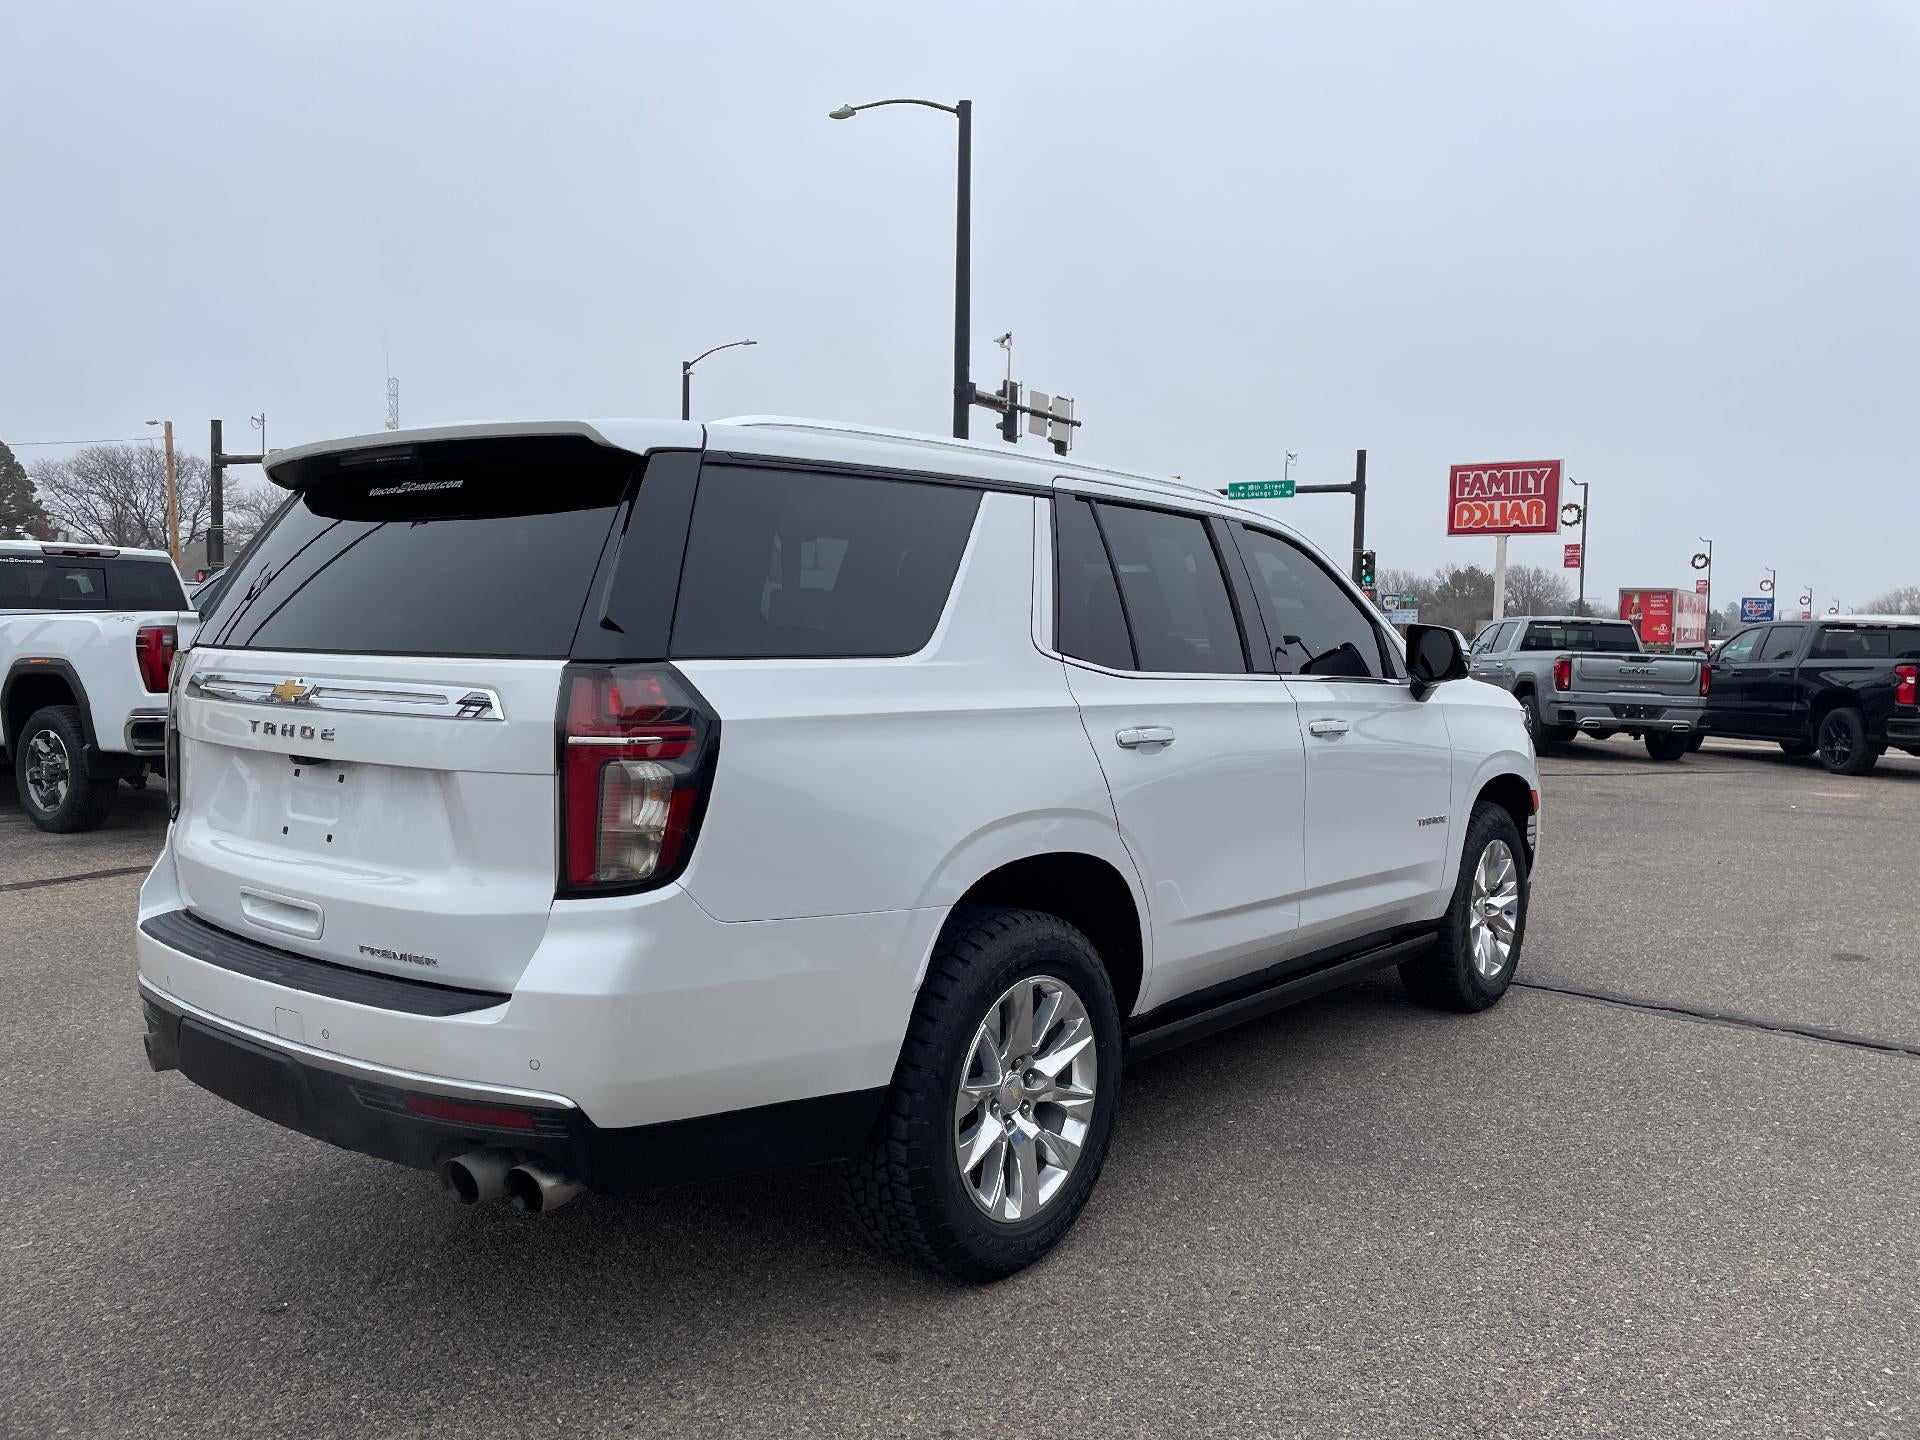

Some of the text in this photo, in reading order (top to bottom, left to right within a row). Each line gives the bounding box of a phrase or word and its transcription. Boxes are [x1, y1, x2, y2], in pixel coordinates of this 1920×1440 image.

[1456, 468, 1551, 498] FAMILY
[1454, 499, 1546, 528] DOLLAR
[1619, 666, 1658, 675] GMC
[249, 719, 336, 742] TAHOE
[1417, 815, 1448, 827] TAHOE
[359, 944, 439, 968] PREMIER
